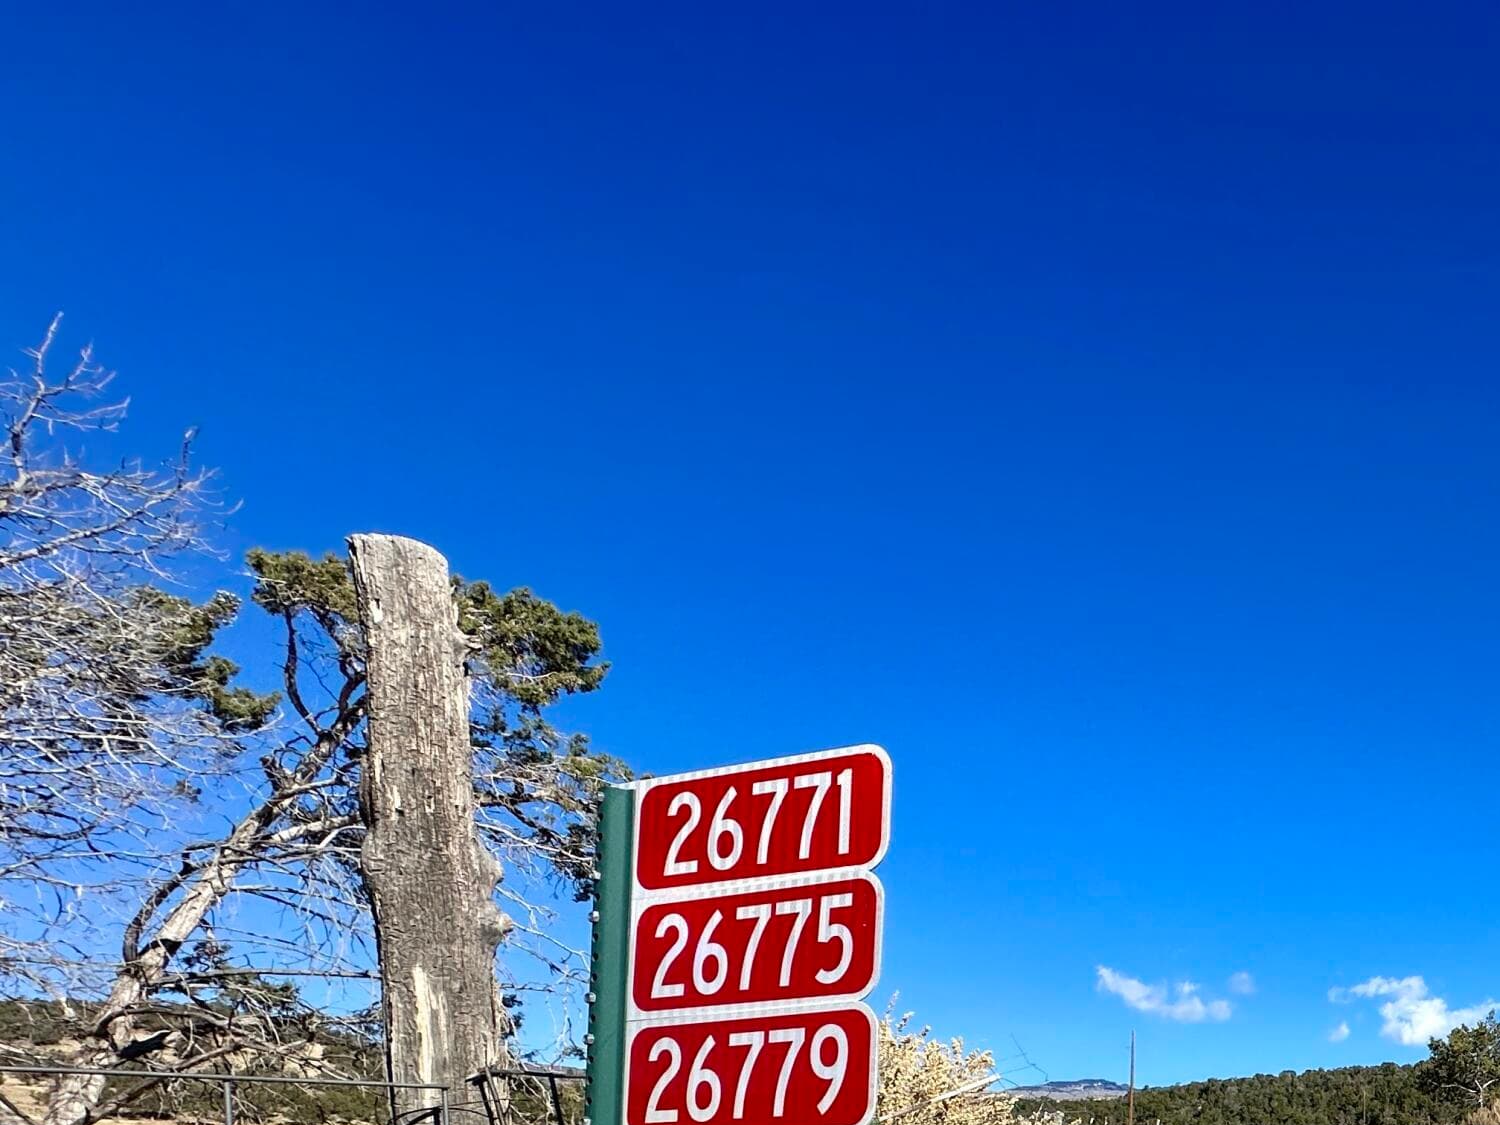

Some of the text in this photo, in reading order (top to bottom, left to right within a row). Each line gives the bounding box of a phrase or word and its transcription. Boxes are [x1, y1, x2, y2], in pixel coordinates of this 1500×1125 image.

[663, 768, 853, 876] 26771
[651, 892, 853, 999] 26775
[644, 1023, 849, 1124] 26779
